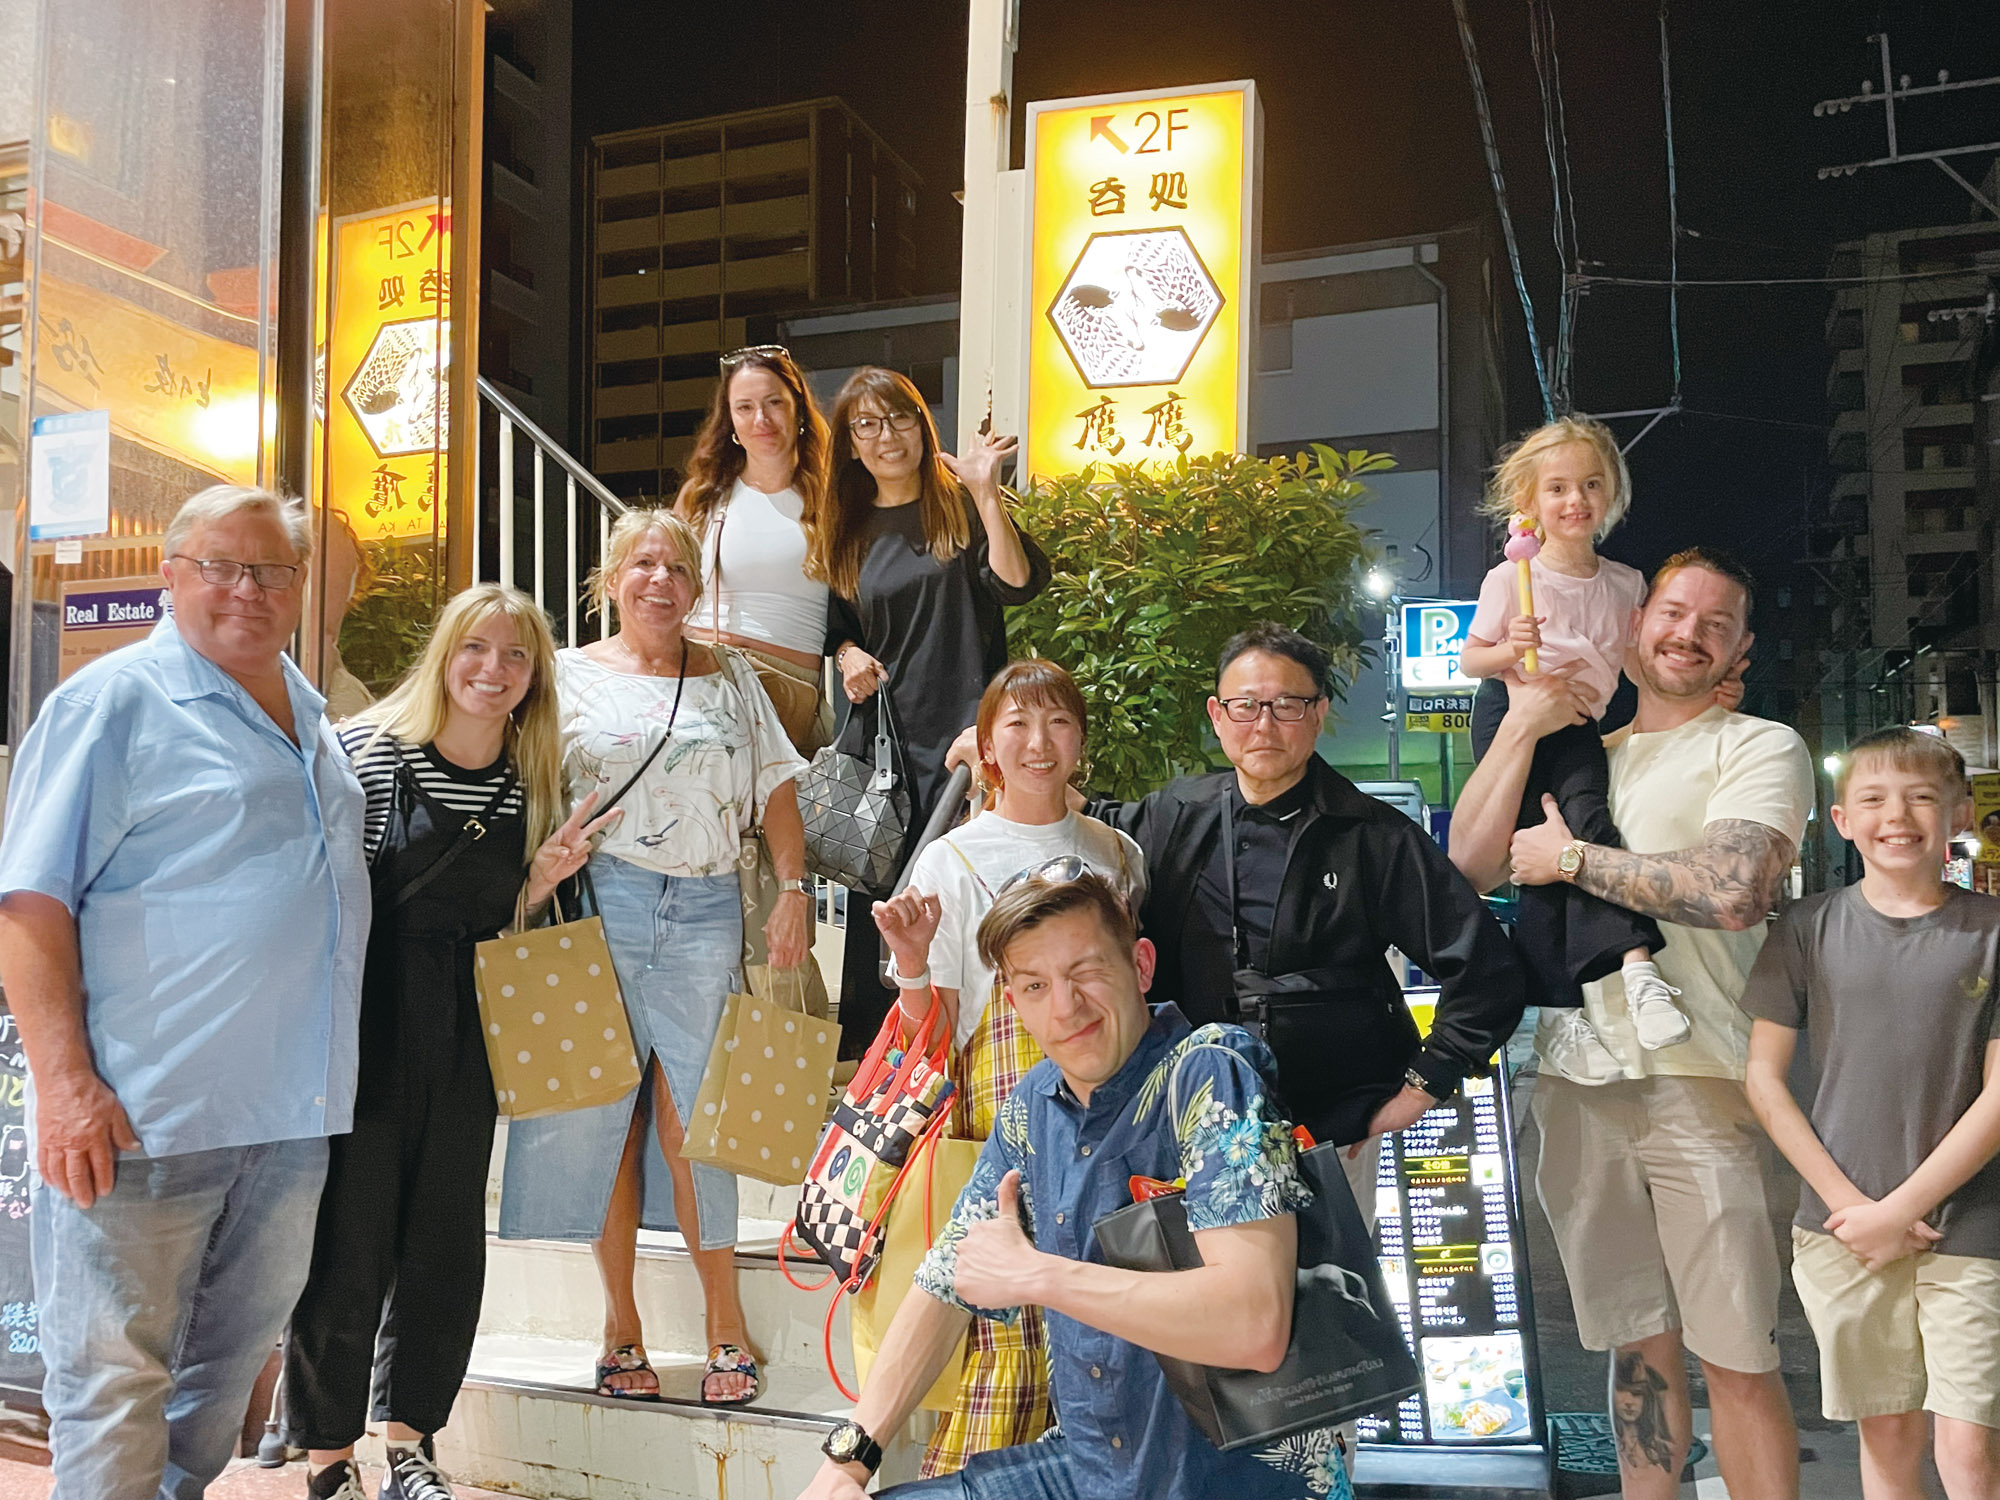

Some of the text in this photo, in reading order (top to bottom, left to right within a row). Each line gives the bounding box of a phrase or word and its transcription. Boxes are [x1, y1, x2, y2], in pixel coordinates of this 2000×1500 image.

[1134, 109, 1188, 154] 2F
[1072, 391, 1193, 456] 鷹鷹
[66, 604, 98, 624] Real
[107, 602, 155, 621] Estate
[1420, 608, 1459, 656] P
[8, 1330, 41, 1353] 820
